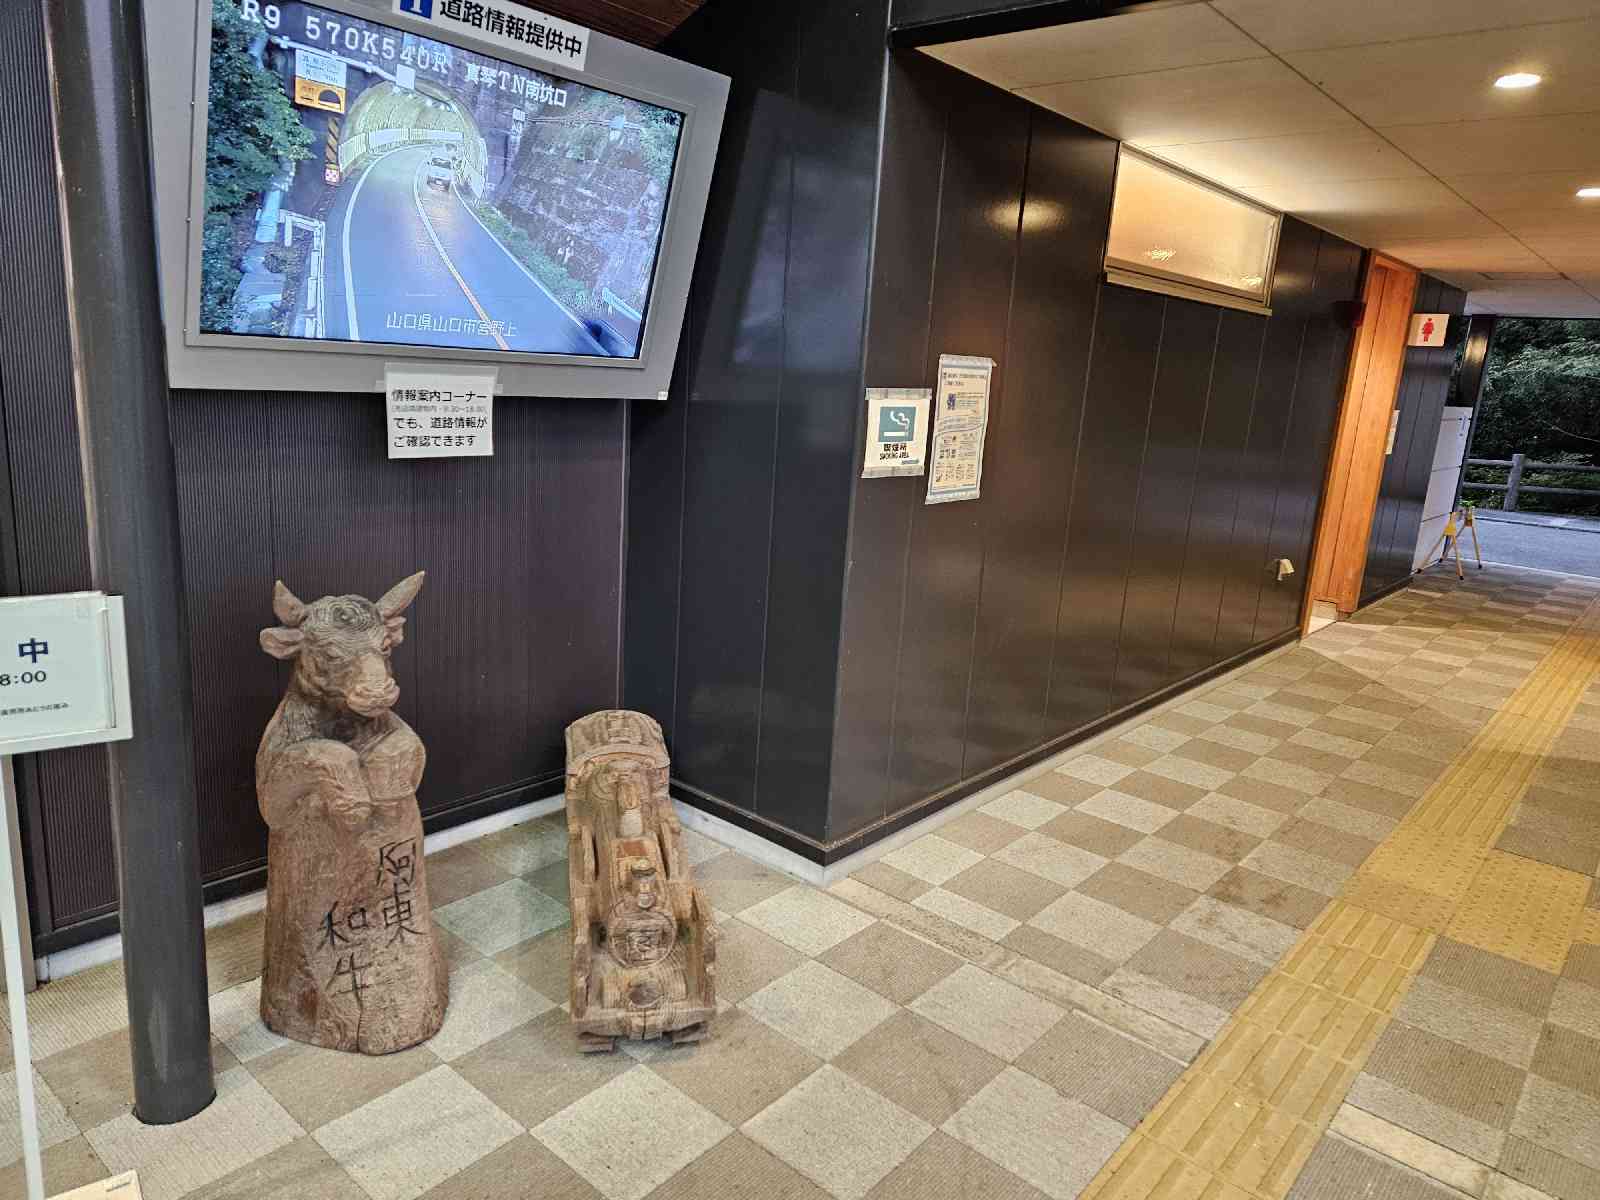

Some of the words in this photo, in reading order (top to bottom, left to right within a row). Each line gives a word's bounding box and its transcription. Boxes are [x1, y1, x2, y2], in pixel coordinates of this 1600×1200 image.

[239, 0, 281, 29] R9
[439, 0, 582, 58] 道路情報提供中
[386, 311, 517, 337] 山口県山口市宮野上
[391, 389, 488, 402] 情報案内コーナー
[393, 435, 477, 448] ご確認できます
[18, 637, 49, 664] 中
